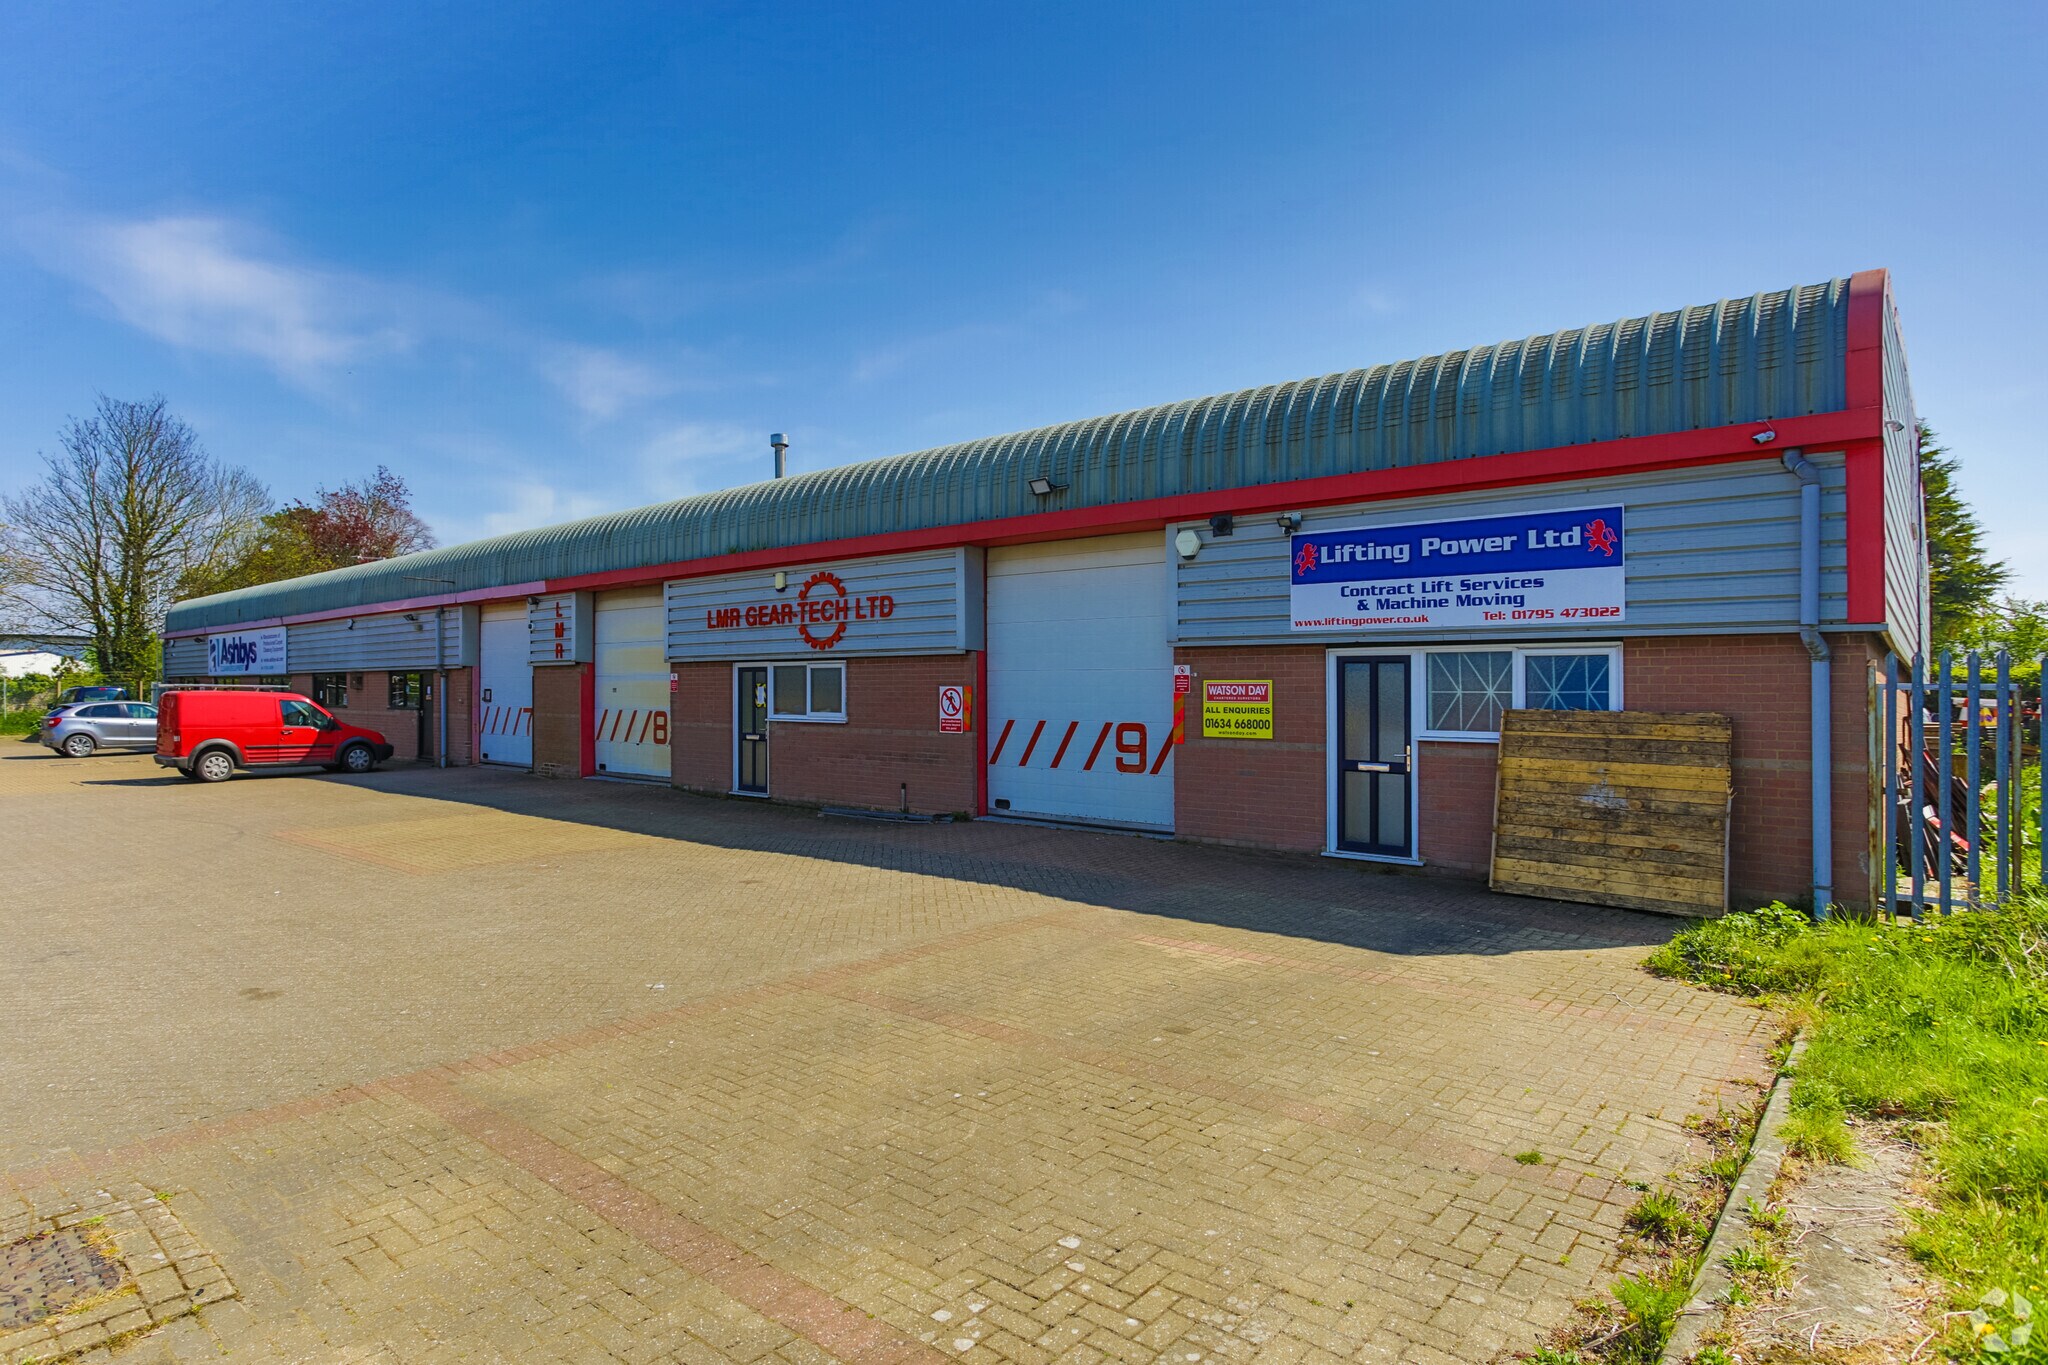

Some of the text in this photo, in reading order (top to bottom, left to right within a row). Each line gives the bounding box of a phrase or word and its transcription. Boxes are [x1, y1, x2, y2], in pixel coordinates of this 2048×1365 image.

[1320, 526, 1581, 564] Lifting Power Ltd
[1340, 577, 1544, 597] Contract Lift Services
[1357, 593, 1525, 611] & Machine Moving
[707, 595, 894, 629] LMR GEAR-TECH LTD
[1294, 614, 1429, 627] www.liftingpower.co.uk
[1483, 607, 1620, 621] Tel: 01795 473022
[221, 636, 257, 671] Ashbys
[1208, 685, 1267, 696] WATSON DAY
[1205, 706, 1271, 715] ALL ENQUIRIES
[653, 710, 668, 745] 8
[1205, 718, 1271, 730] 01634 668000
[1115, 722, 1147, 774] 9
